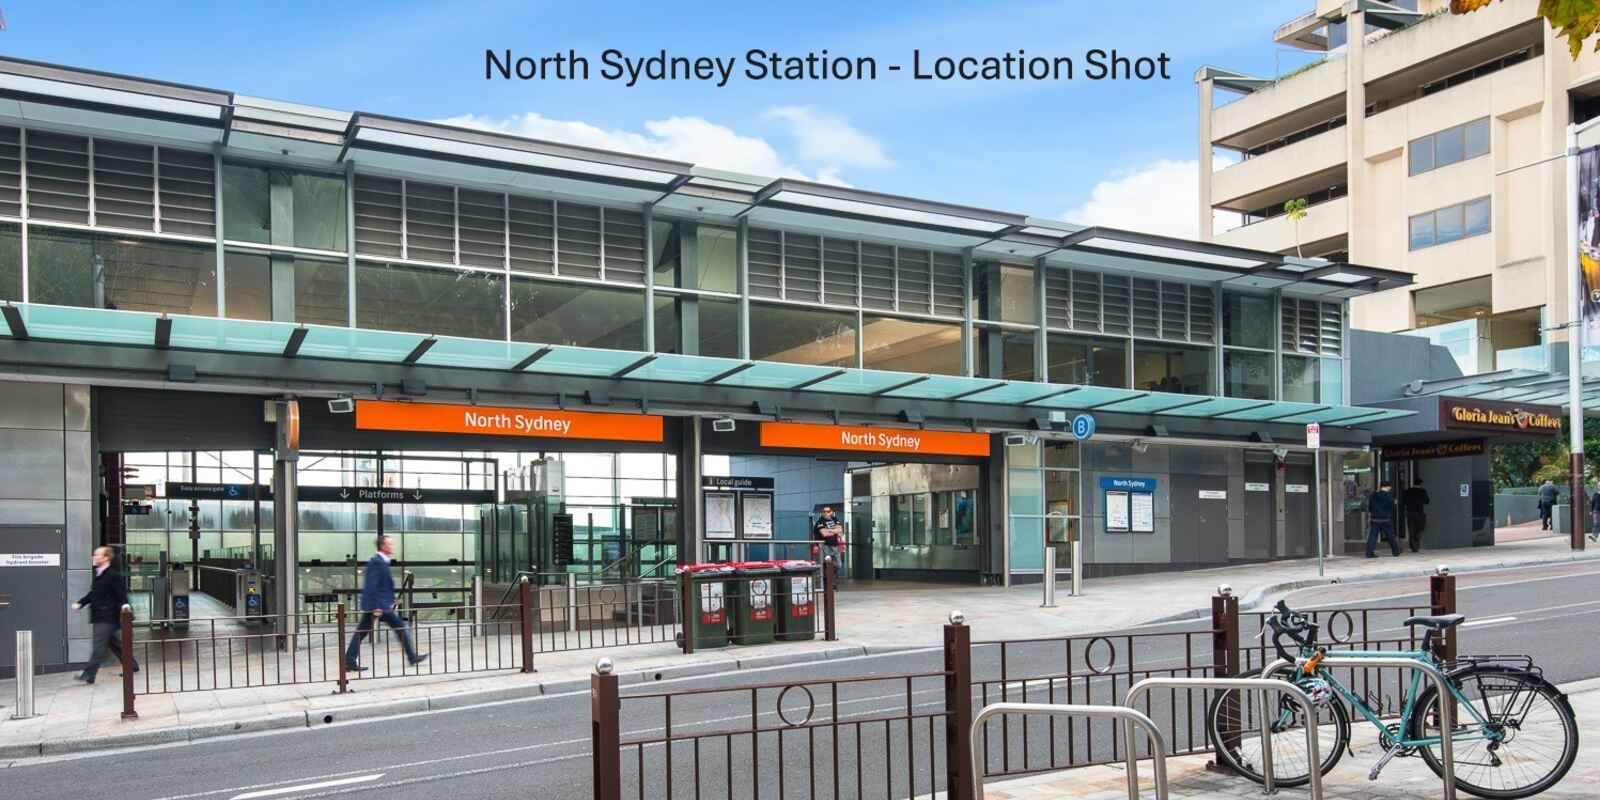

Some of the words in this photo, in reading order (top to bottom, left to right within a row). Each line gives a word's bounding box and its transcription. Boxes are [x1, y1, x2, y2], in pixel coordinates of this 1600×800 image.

[464, 412, 511, 429] North
[515, 414, 571, 434] Sydney
[1452, 405, 1487, 423] Gloria
[1488, 410, 1515, 425] Jean's
[1528, 414, 1561, 429] Coffees
[1077, 419, 1087, 434] B
[841, 431, 876, 446] North
[879, 433, 920, 450] Sydney
[1113, 479, 1127, 487] North
[1128, 479, 1145, 488] Sydney
[359, 489, 404, 499] Platforms
